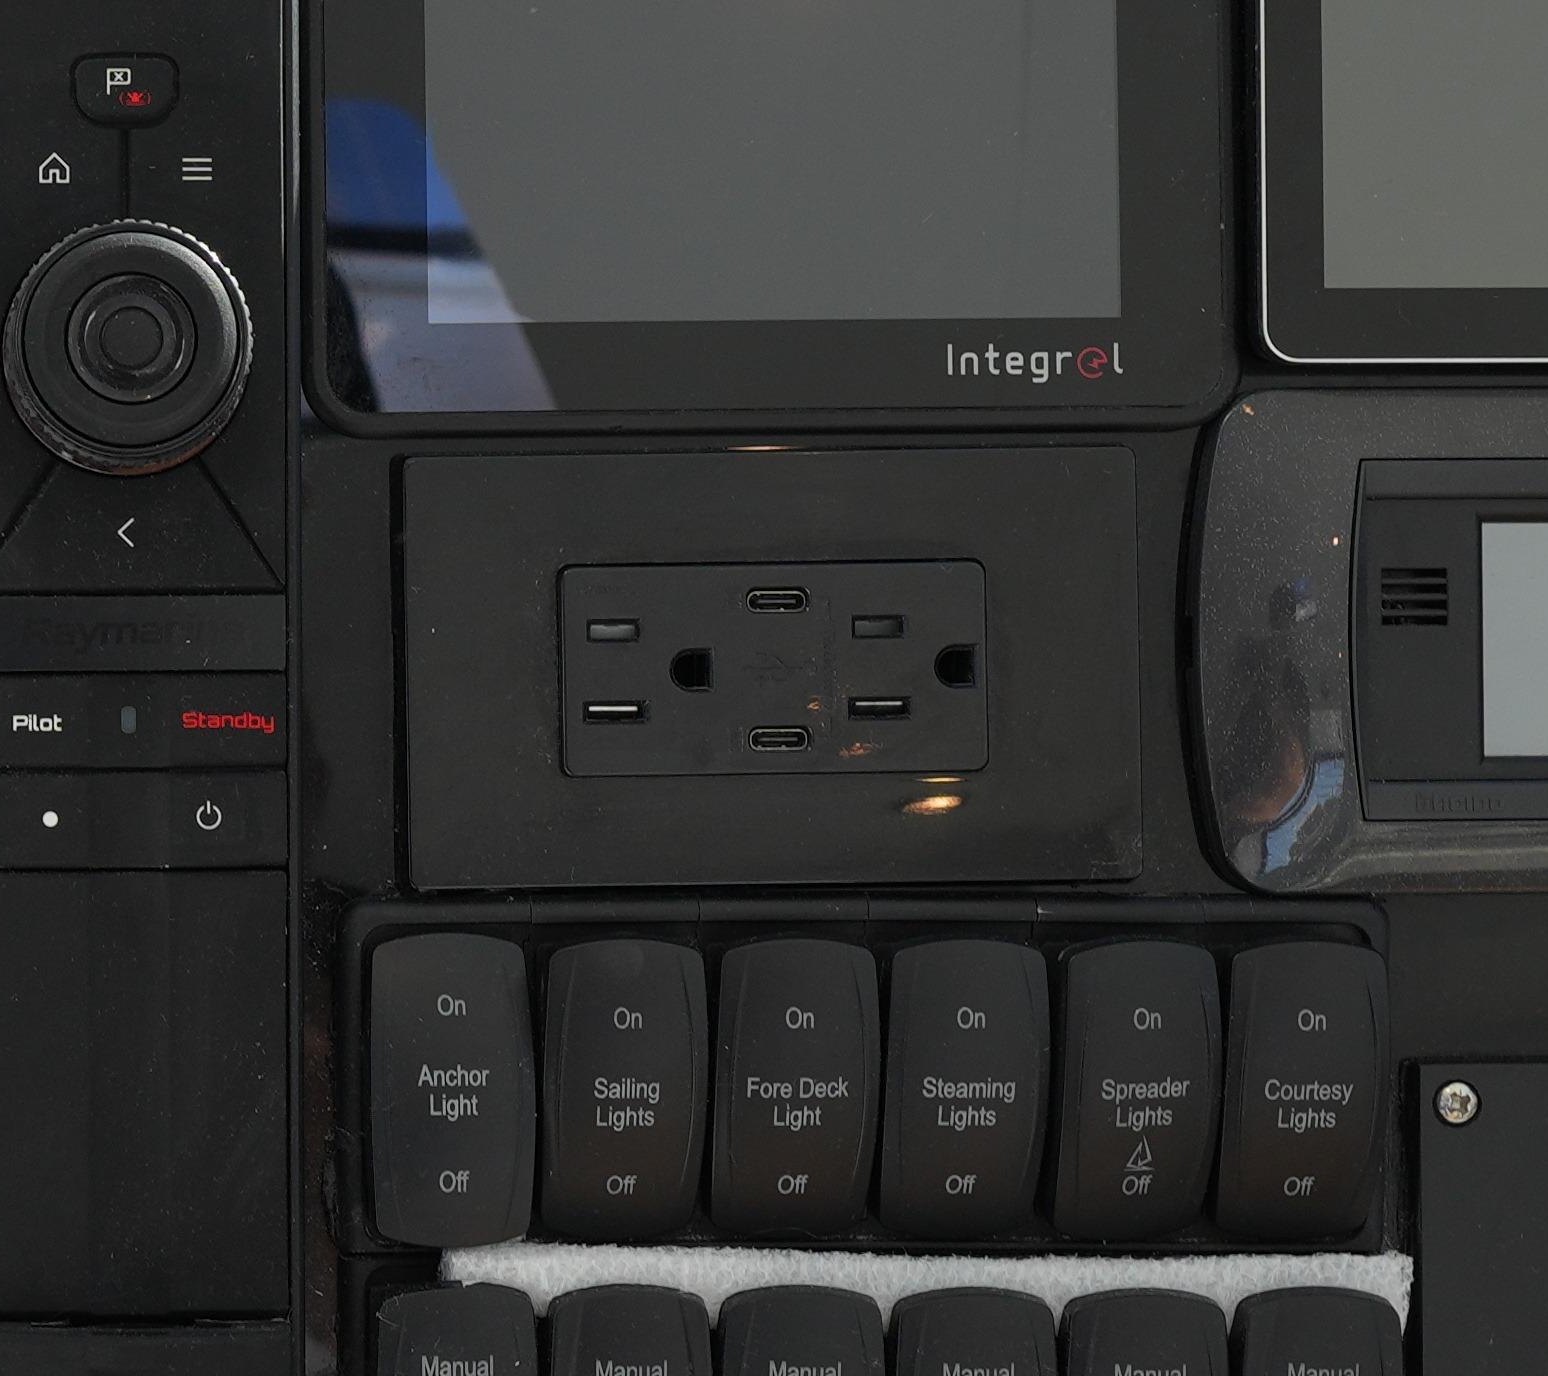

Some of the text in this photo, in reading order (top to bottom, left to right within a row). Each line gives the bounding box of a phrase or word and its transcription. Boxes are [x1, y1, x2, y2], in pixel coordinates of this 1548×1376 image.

[947, 342, 1124, 384] Integrel
[12, 713, 63, 732] Pilot
[182, 711, 275, 734] Standby
[437, 994, 467, 1017] On
[785, 1006, 815, 1029] On
[956, 1006, 986, 1029] On
[613, 1006, 643, 1030] On
[1133, 1007, 1162, 1030] On
[1297, 1008, 1327, 1032] On
[417, 1063, 490, 1087] Anchor
[593, 1077, 660, 1104] Sailing
[746, 1076, 849, 1099] Fore Deck
[922, 1076, 1016, 1104] Steaming
[1101, 1076, 1191, 1105] Spreader
[1264, 1078, 1354, 1106] Courtesy
[429, 1093, 479, 1122] Light
[596, 1105, 655, 1132] Lights
[773, 1103, 822, 1132] Light
[937, 1104, 997, 1132] Lights
[1115, 1105, 1173, 1132] Lights
[1277, 1107, 1336, 1134] Lights
[439, 1170, 470, 1193] Off
[606, 1174, 638, 1195] Off
[777, 1174, 809, 1195] Off
[945, 1174, 977, 1195] Off
[1121, 1174, 1153, 1196] Off
[1283, 1176, 1315, 1196] Off
